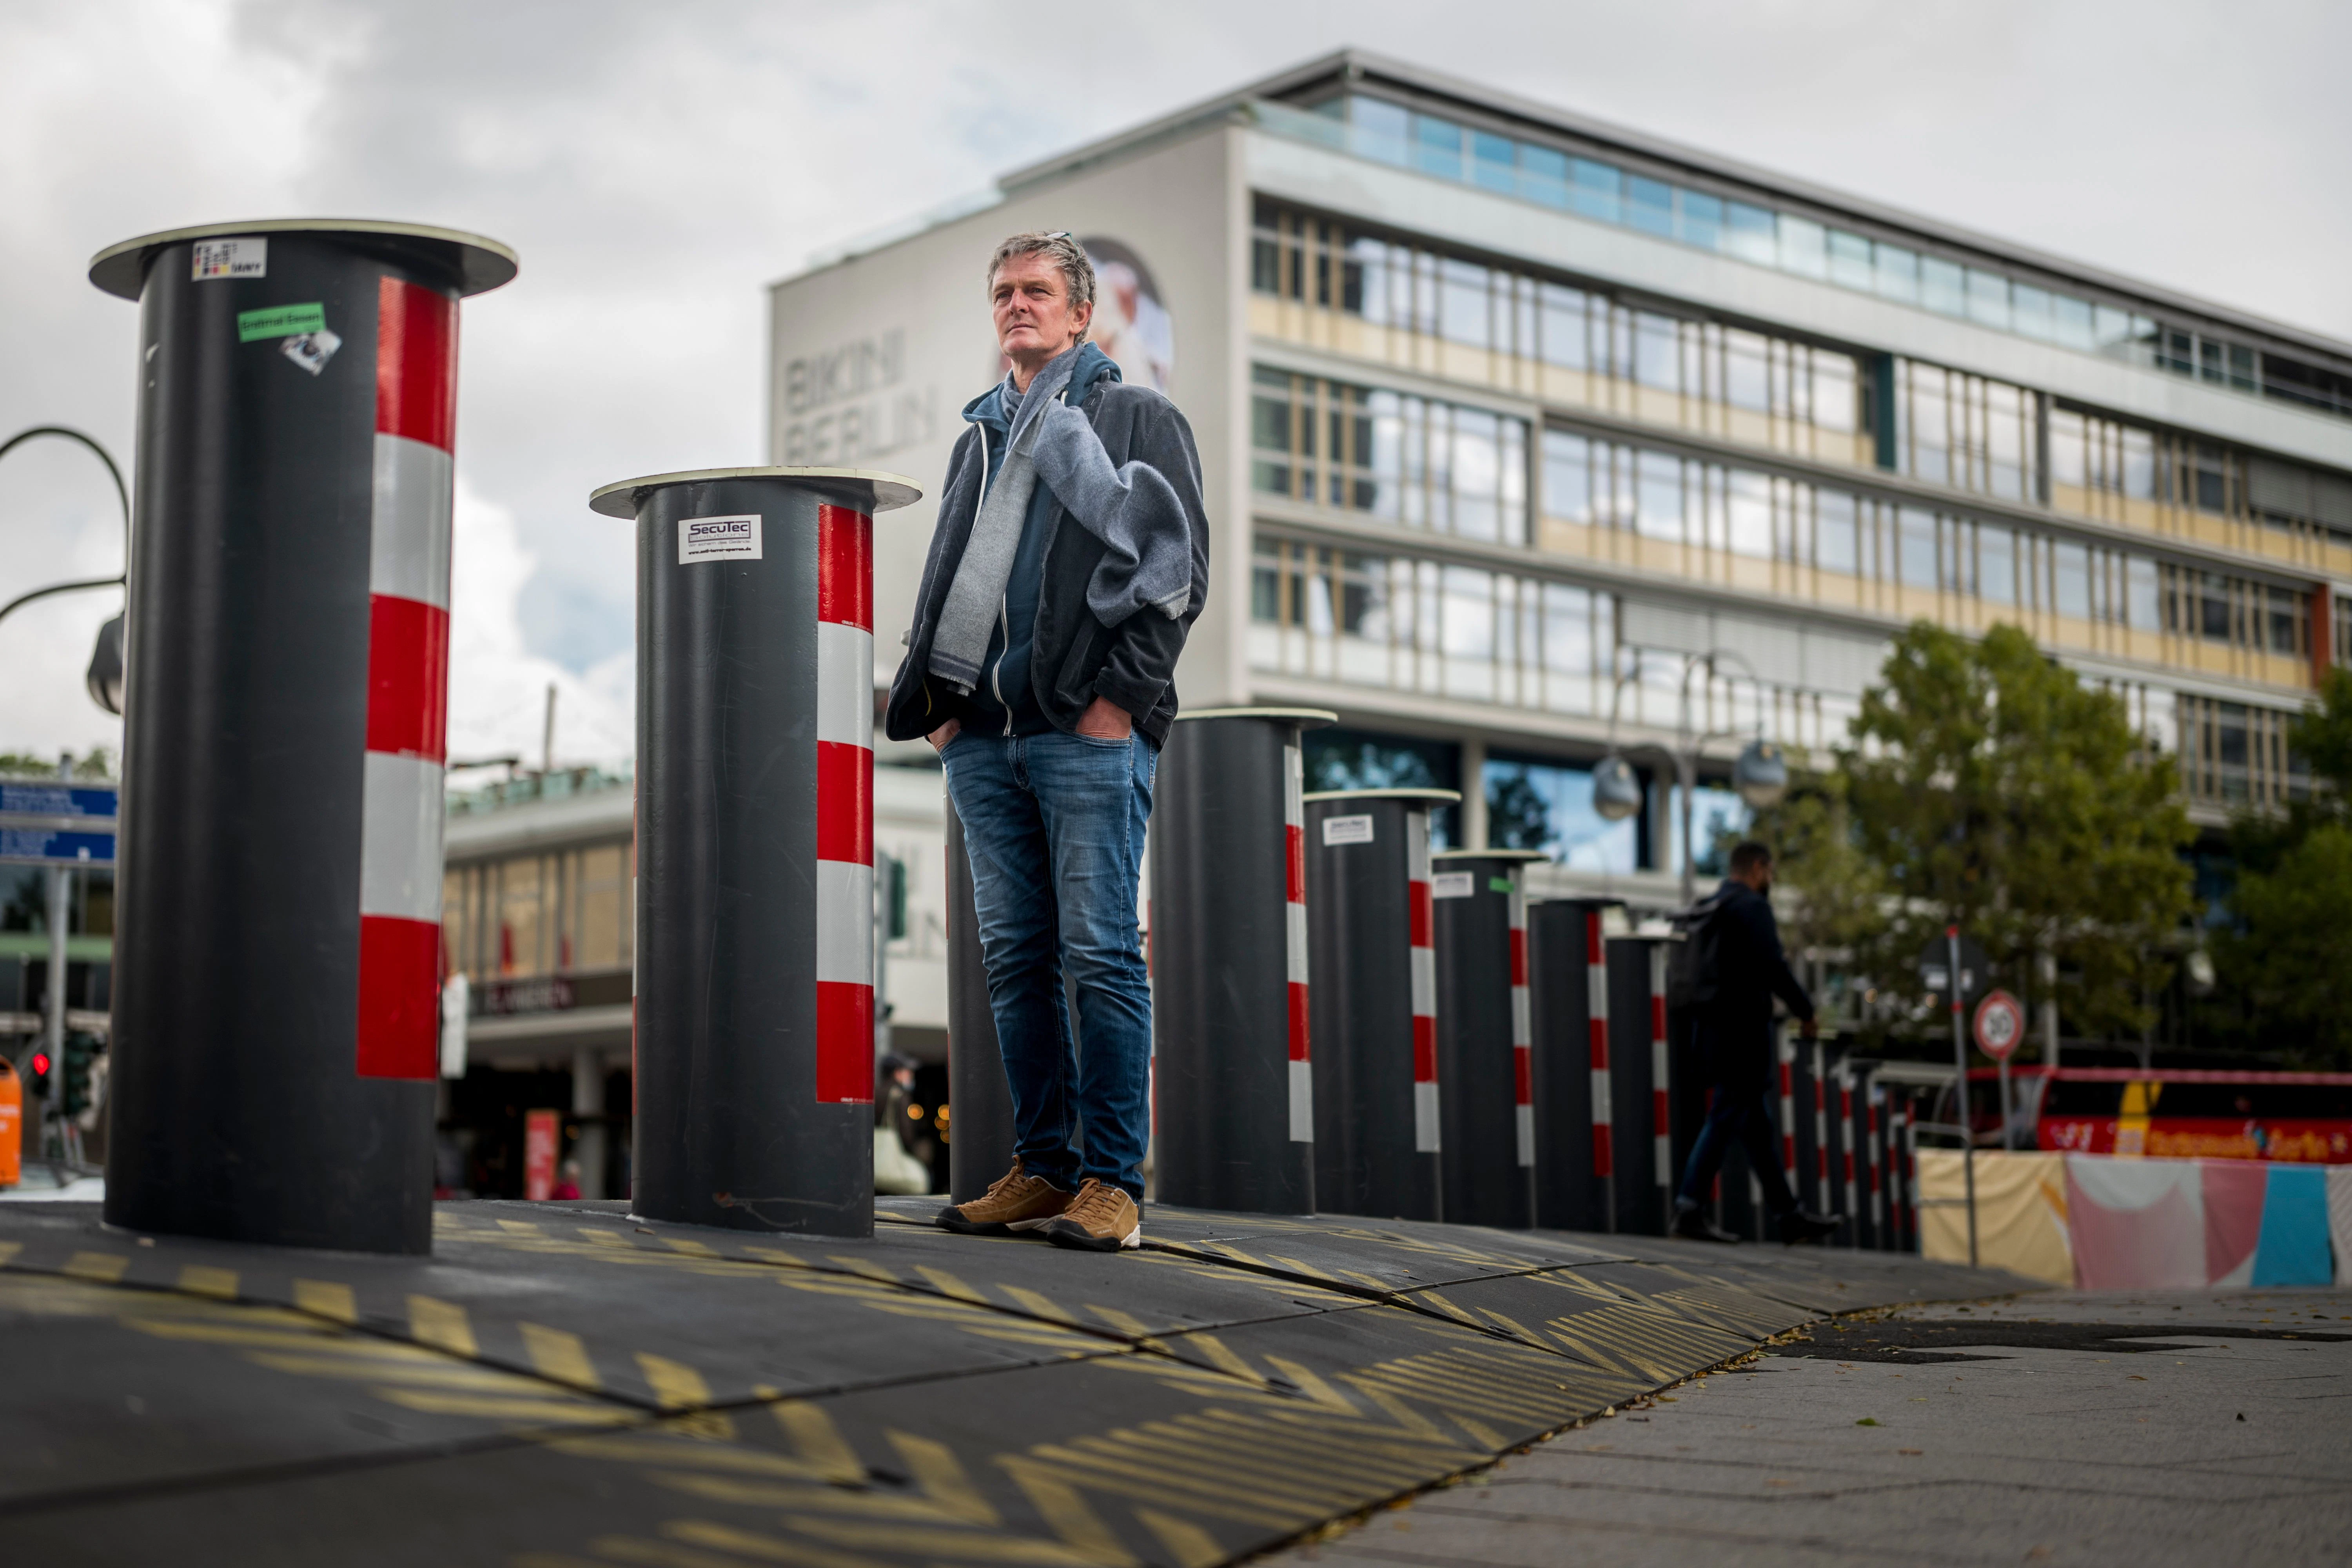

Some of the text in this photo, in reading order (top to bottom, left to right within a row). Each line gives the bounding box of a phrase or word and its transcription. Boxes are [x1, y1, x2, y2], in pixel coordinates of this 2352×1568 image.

[786, 326, 905, 416] BIKINI
[786, 383, 939, 466] BERLIN
[690, 521, 748, 535] SecuTec
